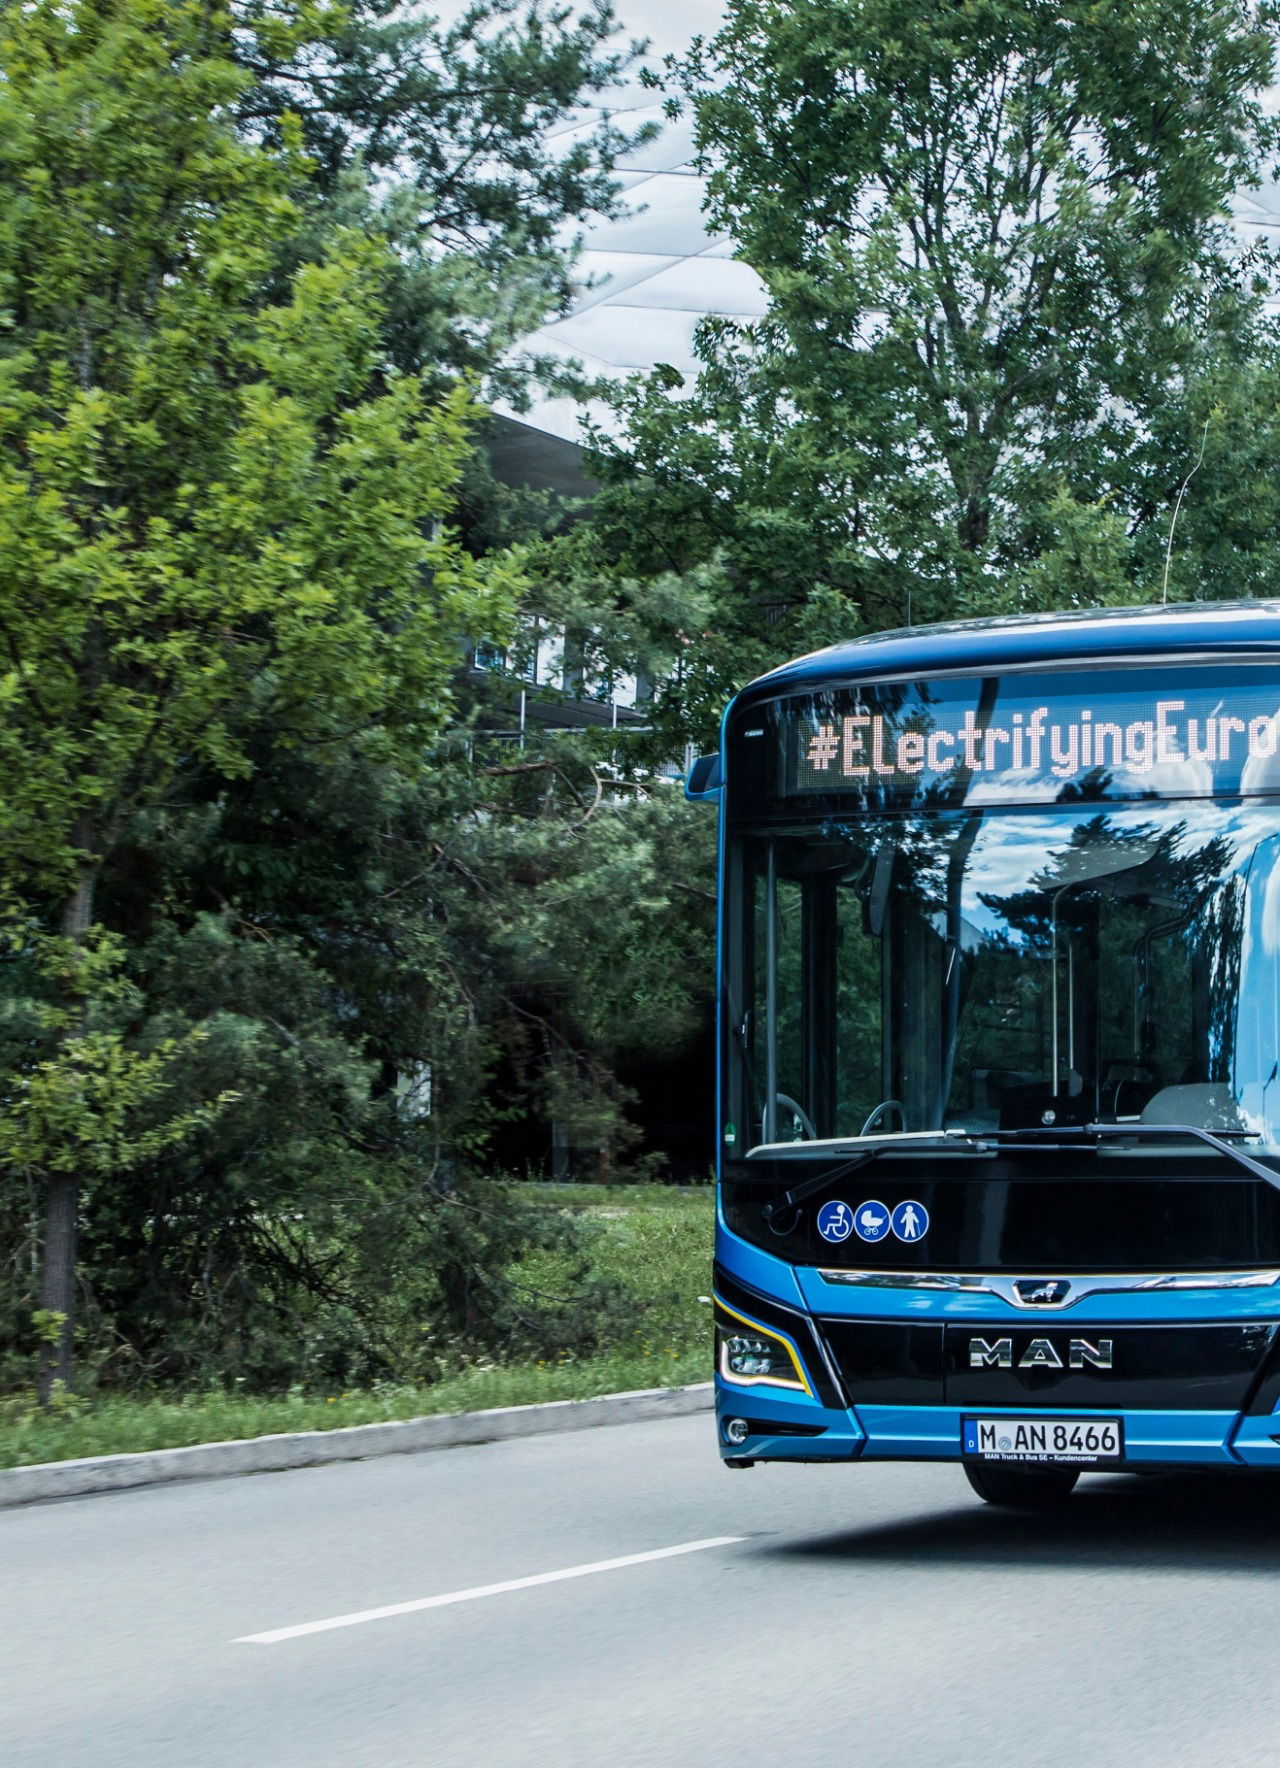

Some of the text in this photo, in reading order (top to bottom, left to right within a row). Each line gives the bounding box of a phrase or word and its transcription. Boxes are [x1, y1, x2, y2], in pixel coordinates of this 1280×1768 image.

[969, 1337, 1113, 1369] MAN
[980, 1424, 996, 1450] M
[1014, 1425, 1046, 1451] AN
[1053, 1425, 1116, 1452] 8466
[1001, 1453, 1018, 1461] Truck
[1054, 1454, 1098, 1462] Kundencenter
